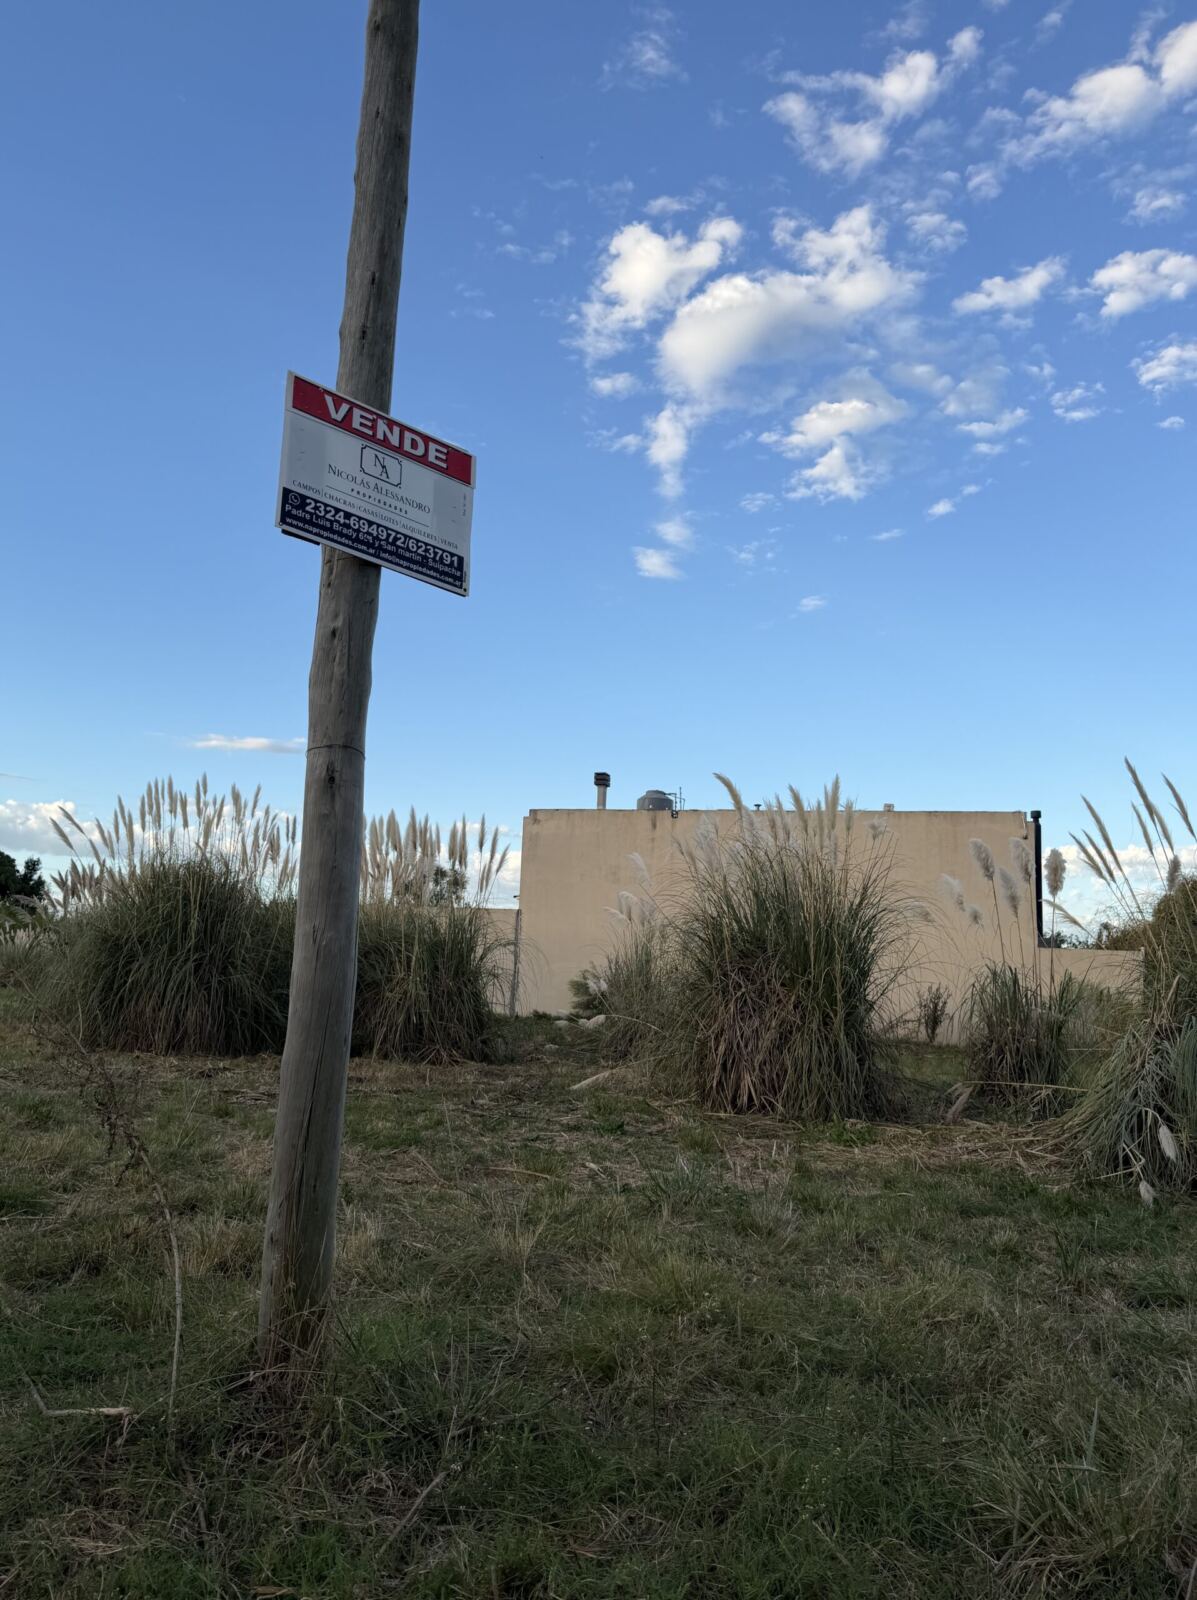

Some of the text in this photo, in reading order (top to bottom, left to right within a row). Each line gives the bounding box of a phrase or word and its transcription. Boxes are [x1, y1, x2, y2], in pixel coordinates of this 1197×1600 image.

[322, 393, 448, 469] VENDE
[358, 504, 377, 517] CASAS
[372, 481, 430, 514] ALESSANDRO
[285, 503, 310, 520] Padre
[312, 514, 330, 528] Luis
[333, 522, 356, 539] Brady
[380, 539, 396, 552] San
[285, 516, 375, 555] www.napropiedades.com.ar
[304, 497, 457, 567] 2324-694972/623791
